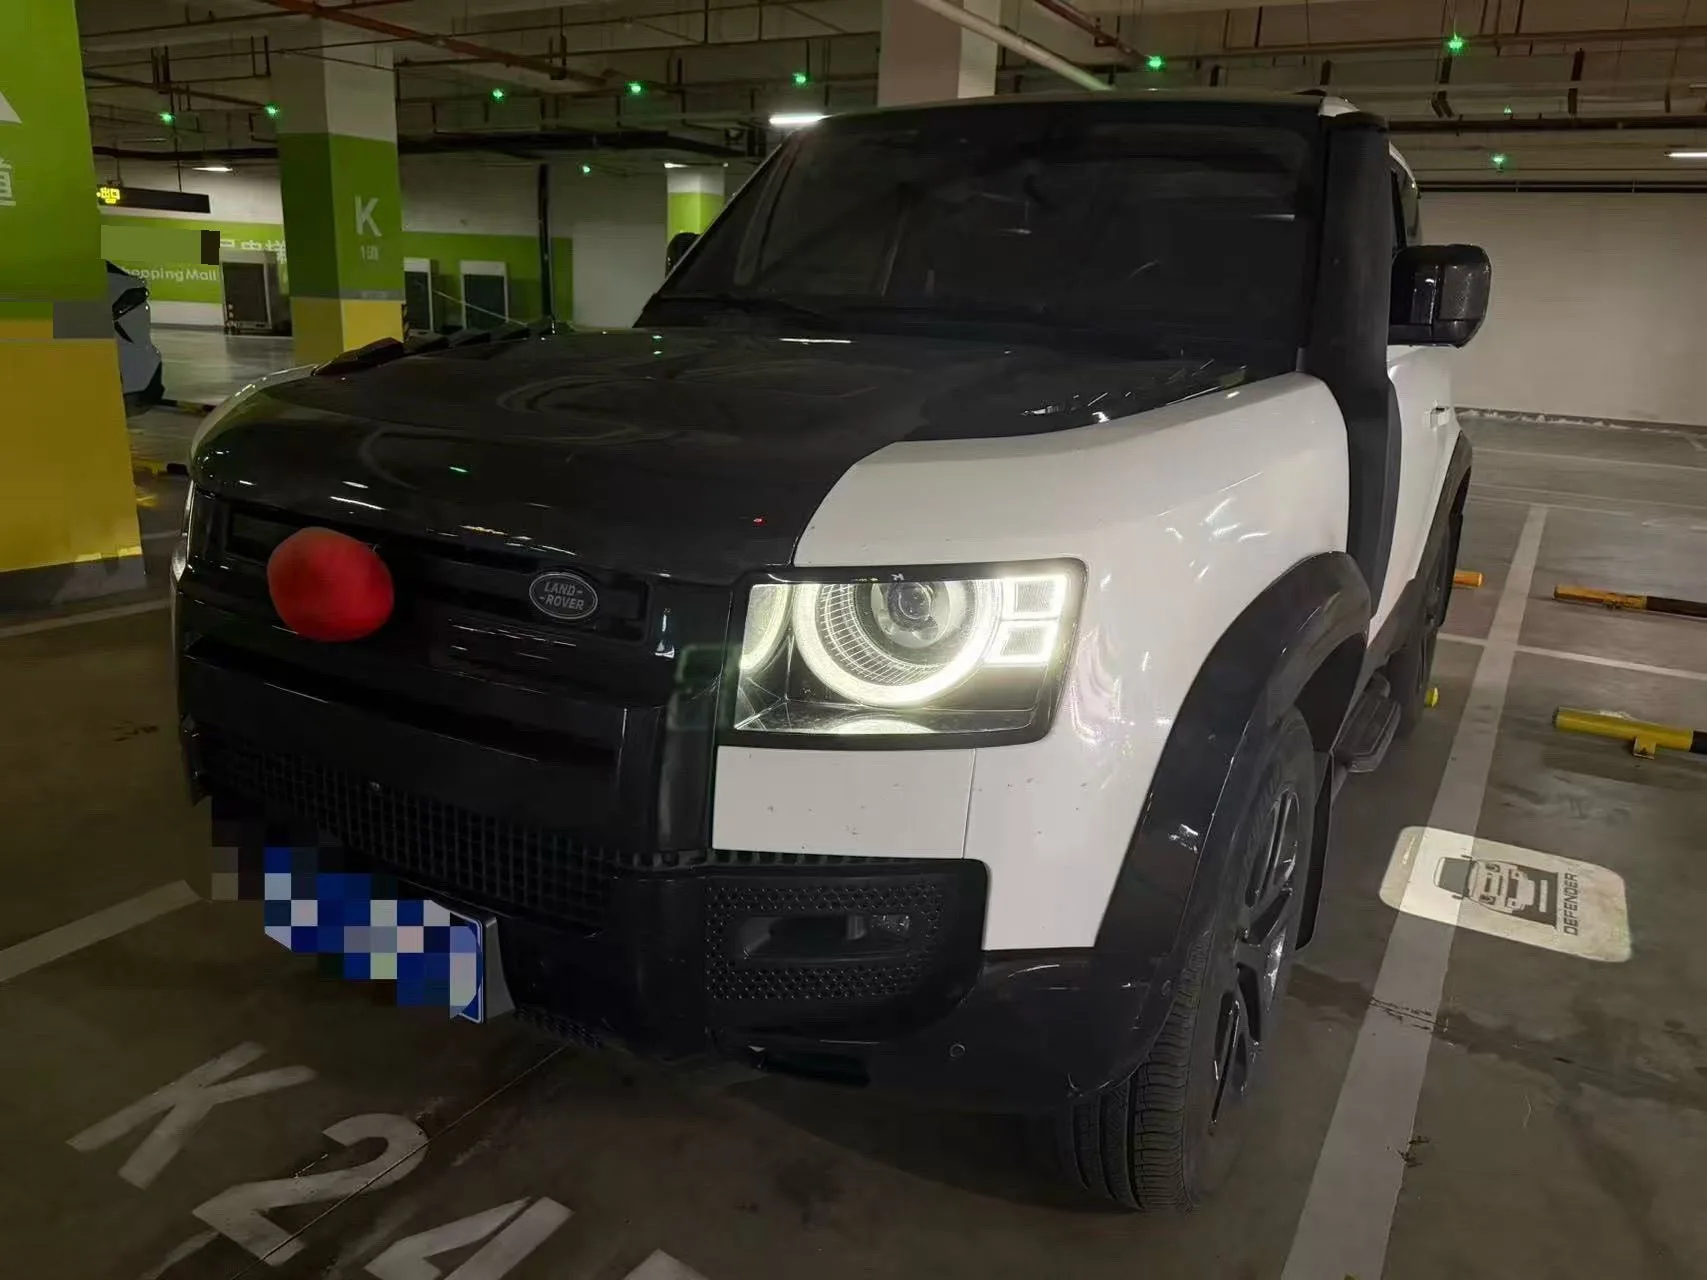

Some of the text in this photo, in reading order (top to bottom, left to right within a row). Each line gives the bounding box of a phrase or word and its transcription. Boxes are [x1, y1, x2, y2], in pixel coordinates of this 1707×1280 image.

[355, 196, 383, 237] K
[186, 268, 217, 280] Mall
[1564, 872, 1579, 936] DEFENDER
